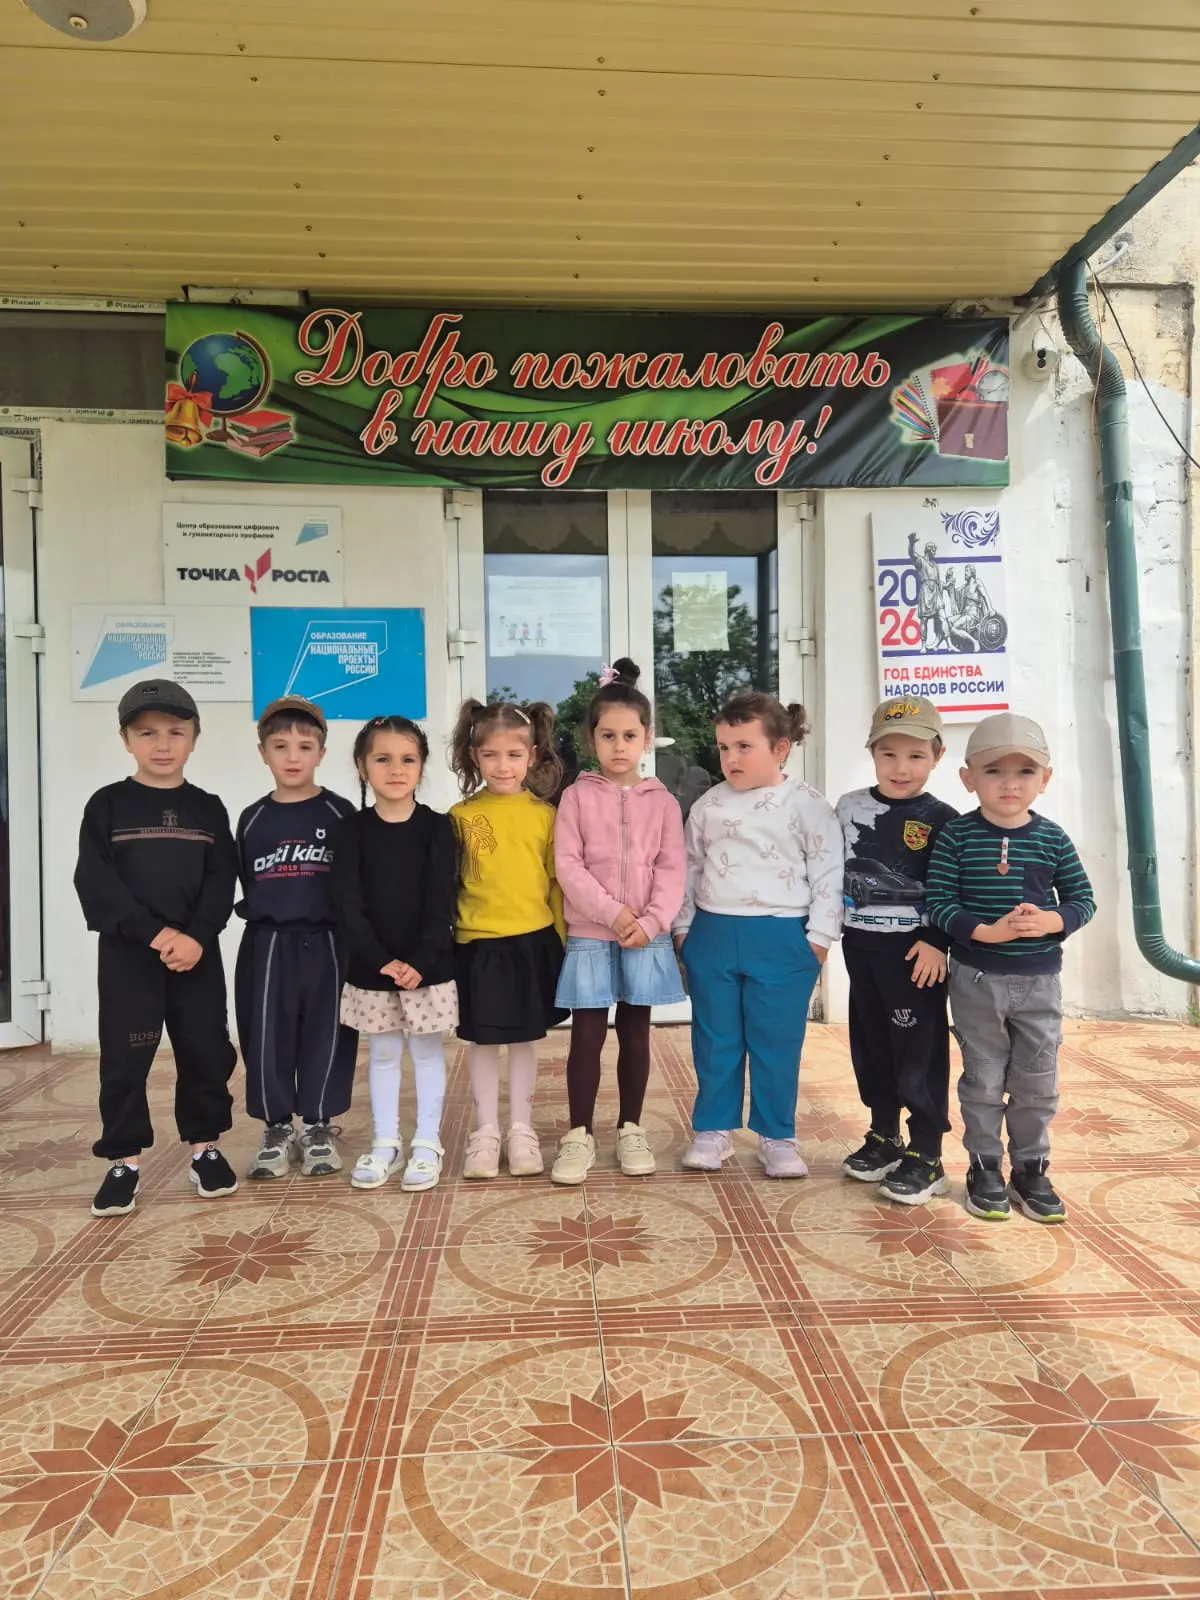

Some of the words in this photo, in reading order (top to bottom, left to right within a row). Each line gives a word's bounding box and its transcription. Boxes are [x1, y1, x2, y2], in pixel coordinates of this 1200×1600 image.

[295, 308, 497, 418] Добро
[510, 322, 891, 389] пожаловать
[360, 389, 398, 455] в
[411, 419, 594, 487] нашу
[607, 405, 832, 486] школу!
[176, 522, 197, 530] Центр
[176, 567, 241, 582] ТОЧКА
[271, 569, 330, 583] РОСТА
[878, 569, 920, 607] 20
[880, 608, 921, 646] 26
[310, 632, 368, 640] ОБРАЗОВАНИЕ
[310, 644, 375, 655] НАЦИОНАЛЬНЫЕ
[338, 654, 376, 664] ПРОЕКТЫ
[345, 664, 376, 674] РОССИИ
[884, 667, 910, 681] ГОД
[914, 665, 983, 680] ЕДИНСТВА
[884, 682, 947, 697] НАРОДОВ
[950, 680, 1005, 694] РОССИИ
[292, 844, 334, 863] kids
[277, 864, 298, 872] 2019
